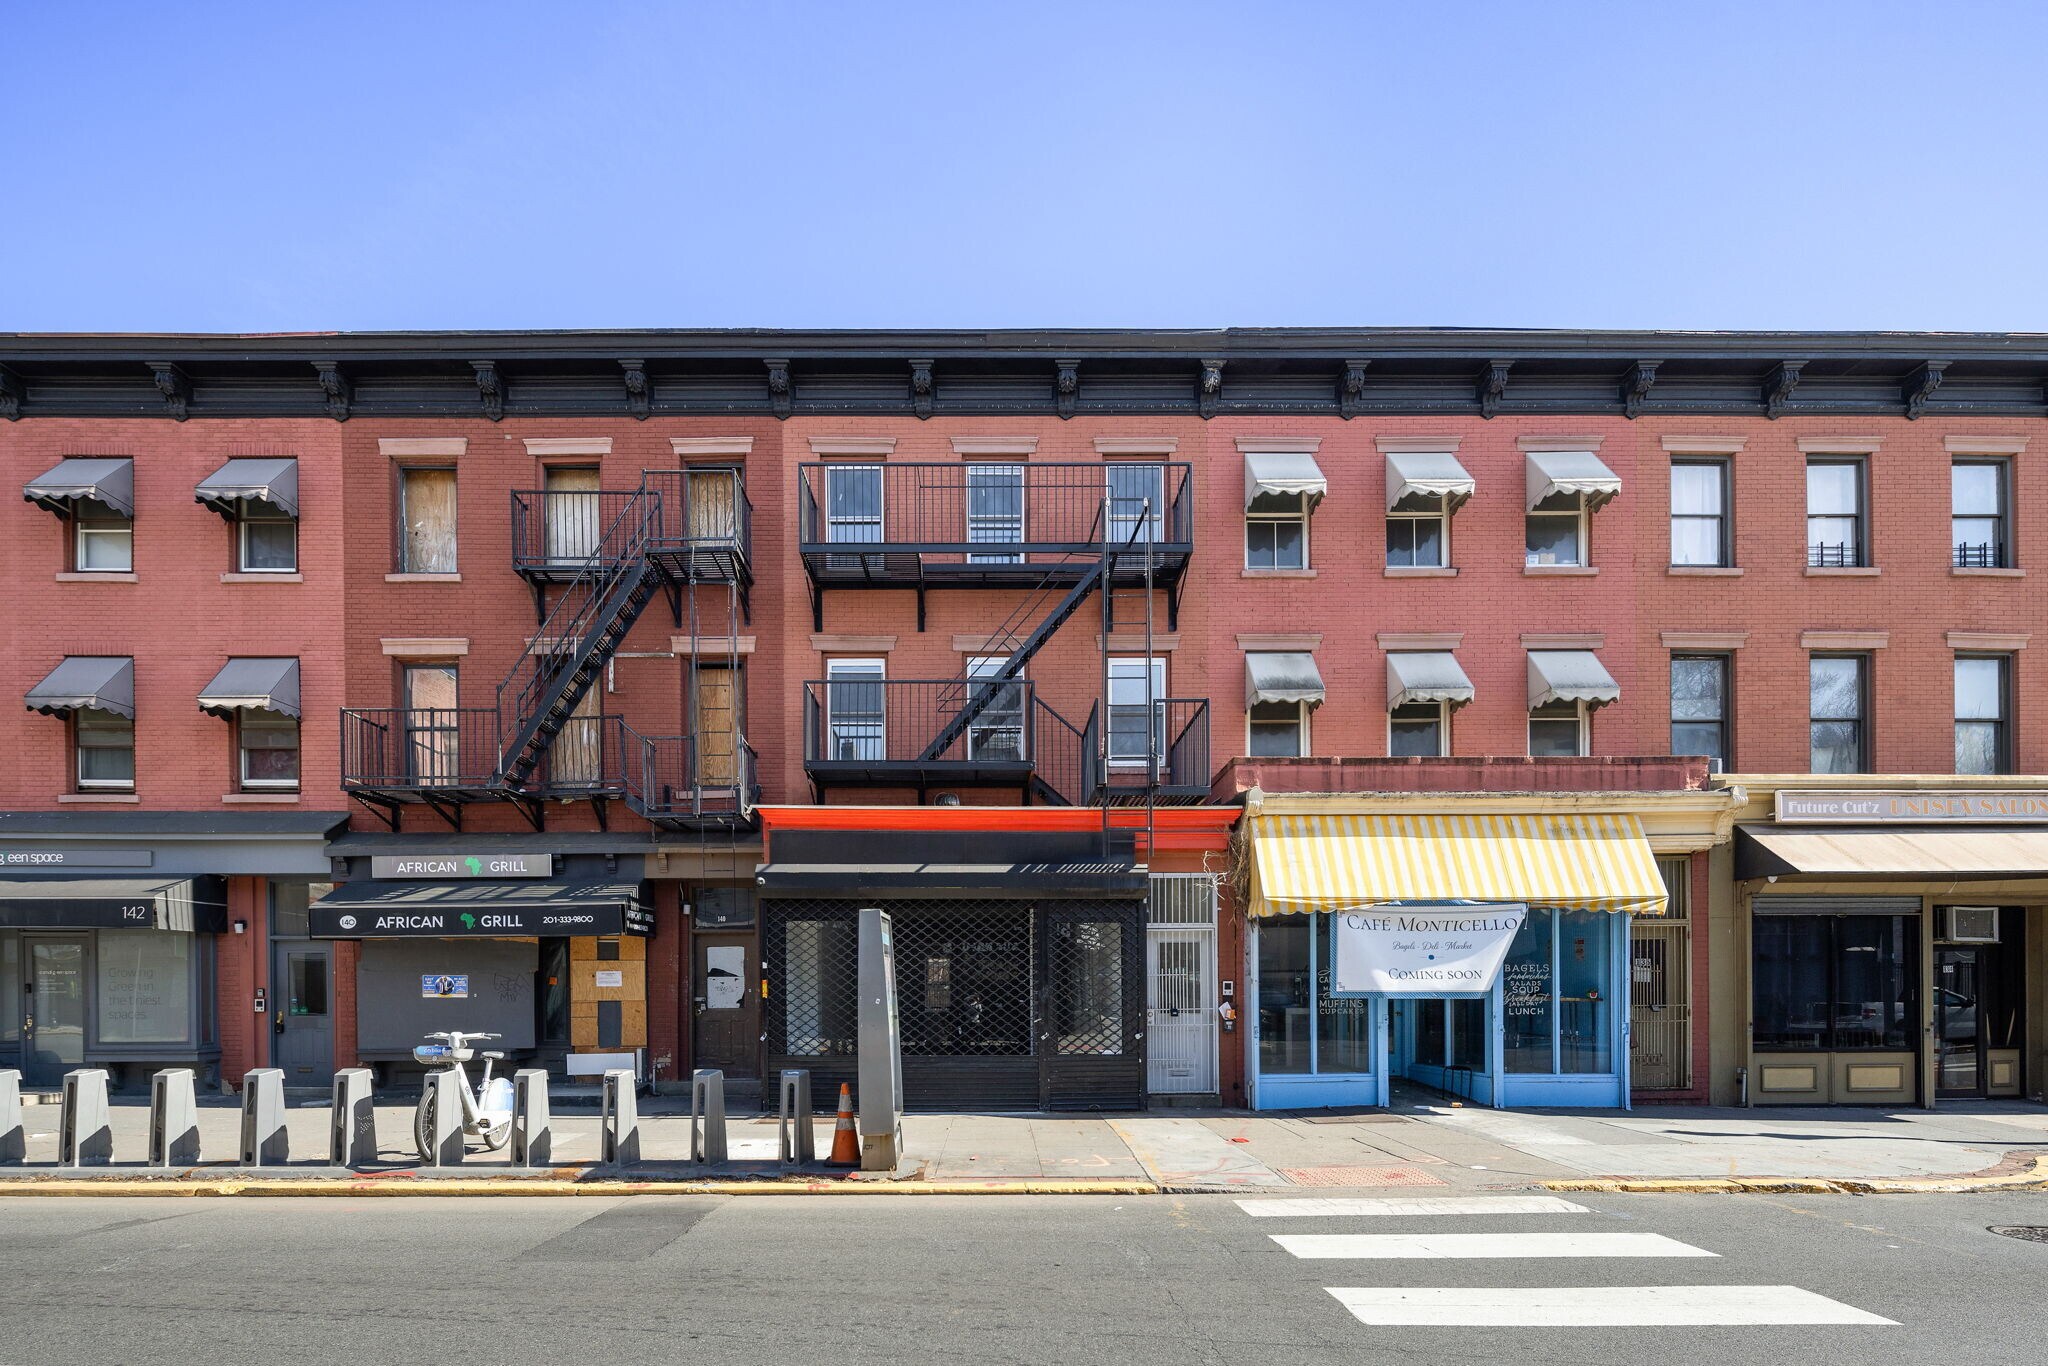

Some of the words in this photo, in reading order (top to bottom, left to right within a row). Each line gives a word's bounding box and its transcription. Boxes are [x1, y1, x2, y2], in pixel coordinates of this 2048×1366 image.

[1788, 800, 1839, 814] Future
[1842, 800, 1880, 814] Cut'z
[1890, 798, 1973, 816] UNISEX
[30, 852, 64, 864] space
[397, 861, 457, 873] AFRICAN
[490, 861, 527, 872] GRILL
[121, 906, 146, 919] 142
[341, 917, 355, 927] 140
[375, 915, 444, 928] AFRICAN
[481, 915, 523, 928] GRILL
[543, 915, 594, 924] 201-333-9800
[1347, 914, 1391, 931] CAFÉ
[1397, 916, 1518, 933] MONTICELLO
[1392, 941, 1416, 952] Bagels
[1421, 941, 1439, 951] Deli
[1444, 941, 1473, 951] Market
[108, 967, 153, 979] Growng
[1388, 967, 1444, 980] COMING
[1504, 963, 1550, 972] BAGELS
[1512, 985, 1540, 994] SOUP
[1319, 1000, 1364, 1008] MUFFINS
[1503, 992, 1551, 1005] breakfast
[1508, 1007, 1544, 1015] LUNCH
